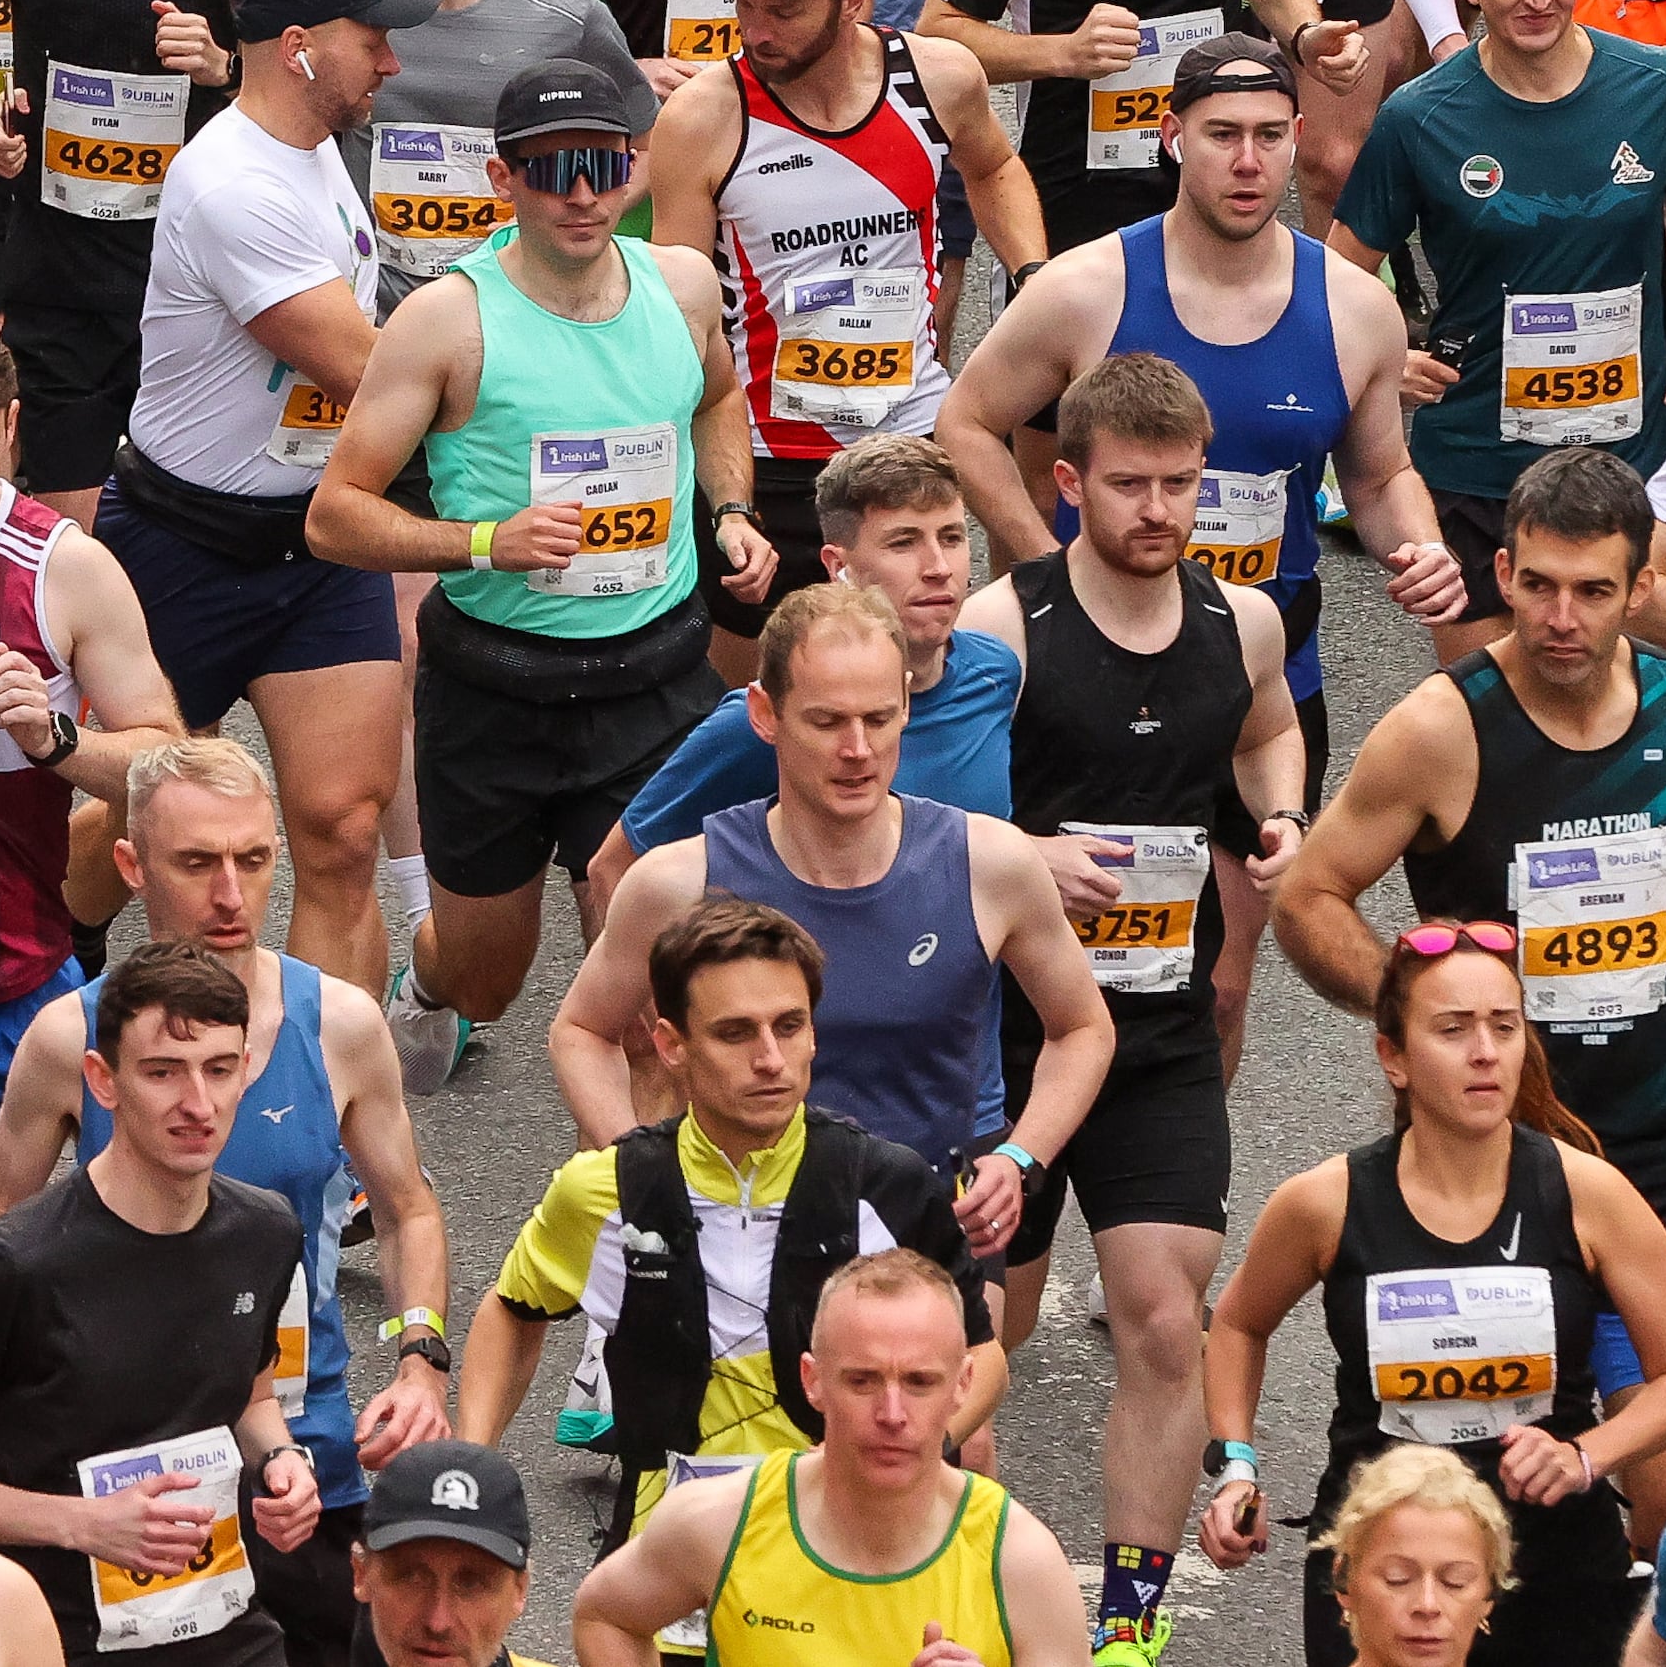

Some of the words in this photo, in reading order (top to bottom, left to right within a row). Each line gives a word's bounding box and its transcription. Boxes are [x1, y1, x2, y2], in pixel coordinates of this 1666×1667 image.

[122, 87, 174, 103] DUBLIN
[538, 90, 583, 103] KIPRUN
[92, 117, 119, 128] DYLAN
[1139, 129, 1161, 140] JOHN
[58, 145, 163, 178] 4628
[418, 171, 448, 183] BARRY
[90, 207, 121, 220] 4628
[390, 198, 497, 232] 3054
[772, 210, 927, 254] ROADRUNNERS
[839, 242, 869, 268] AC
[794, 346, 899, 380] 3685
[1524, 365, 1624, 403] 4538
[614, 440, 663, 456] DUBLIN
[578, 507, 656, 548] 652
[593, 582, 623, 594] 4652
[1542, 812, 1652, 840] MARATHON
[1542, 923, 1658, 967] 4893
[1466, 1287, 1531, 1301] DUBLIN
[1401, 1360, 1531, 1402] 2042
[1450, 1426, 1488, 1439] 2042
[172, 1450, 227, 1472] DUBLIN
[172, 1621, 198, 1637] 698
[761, 1615, 815, 1633] ROLO
